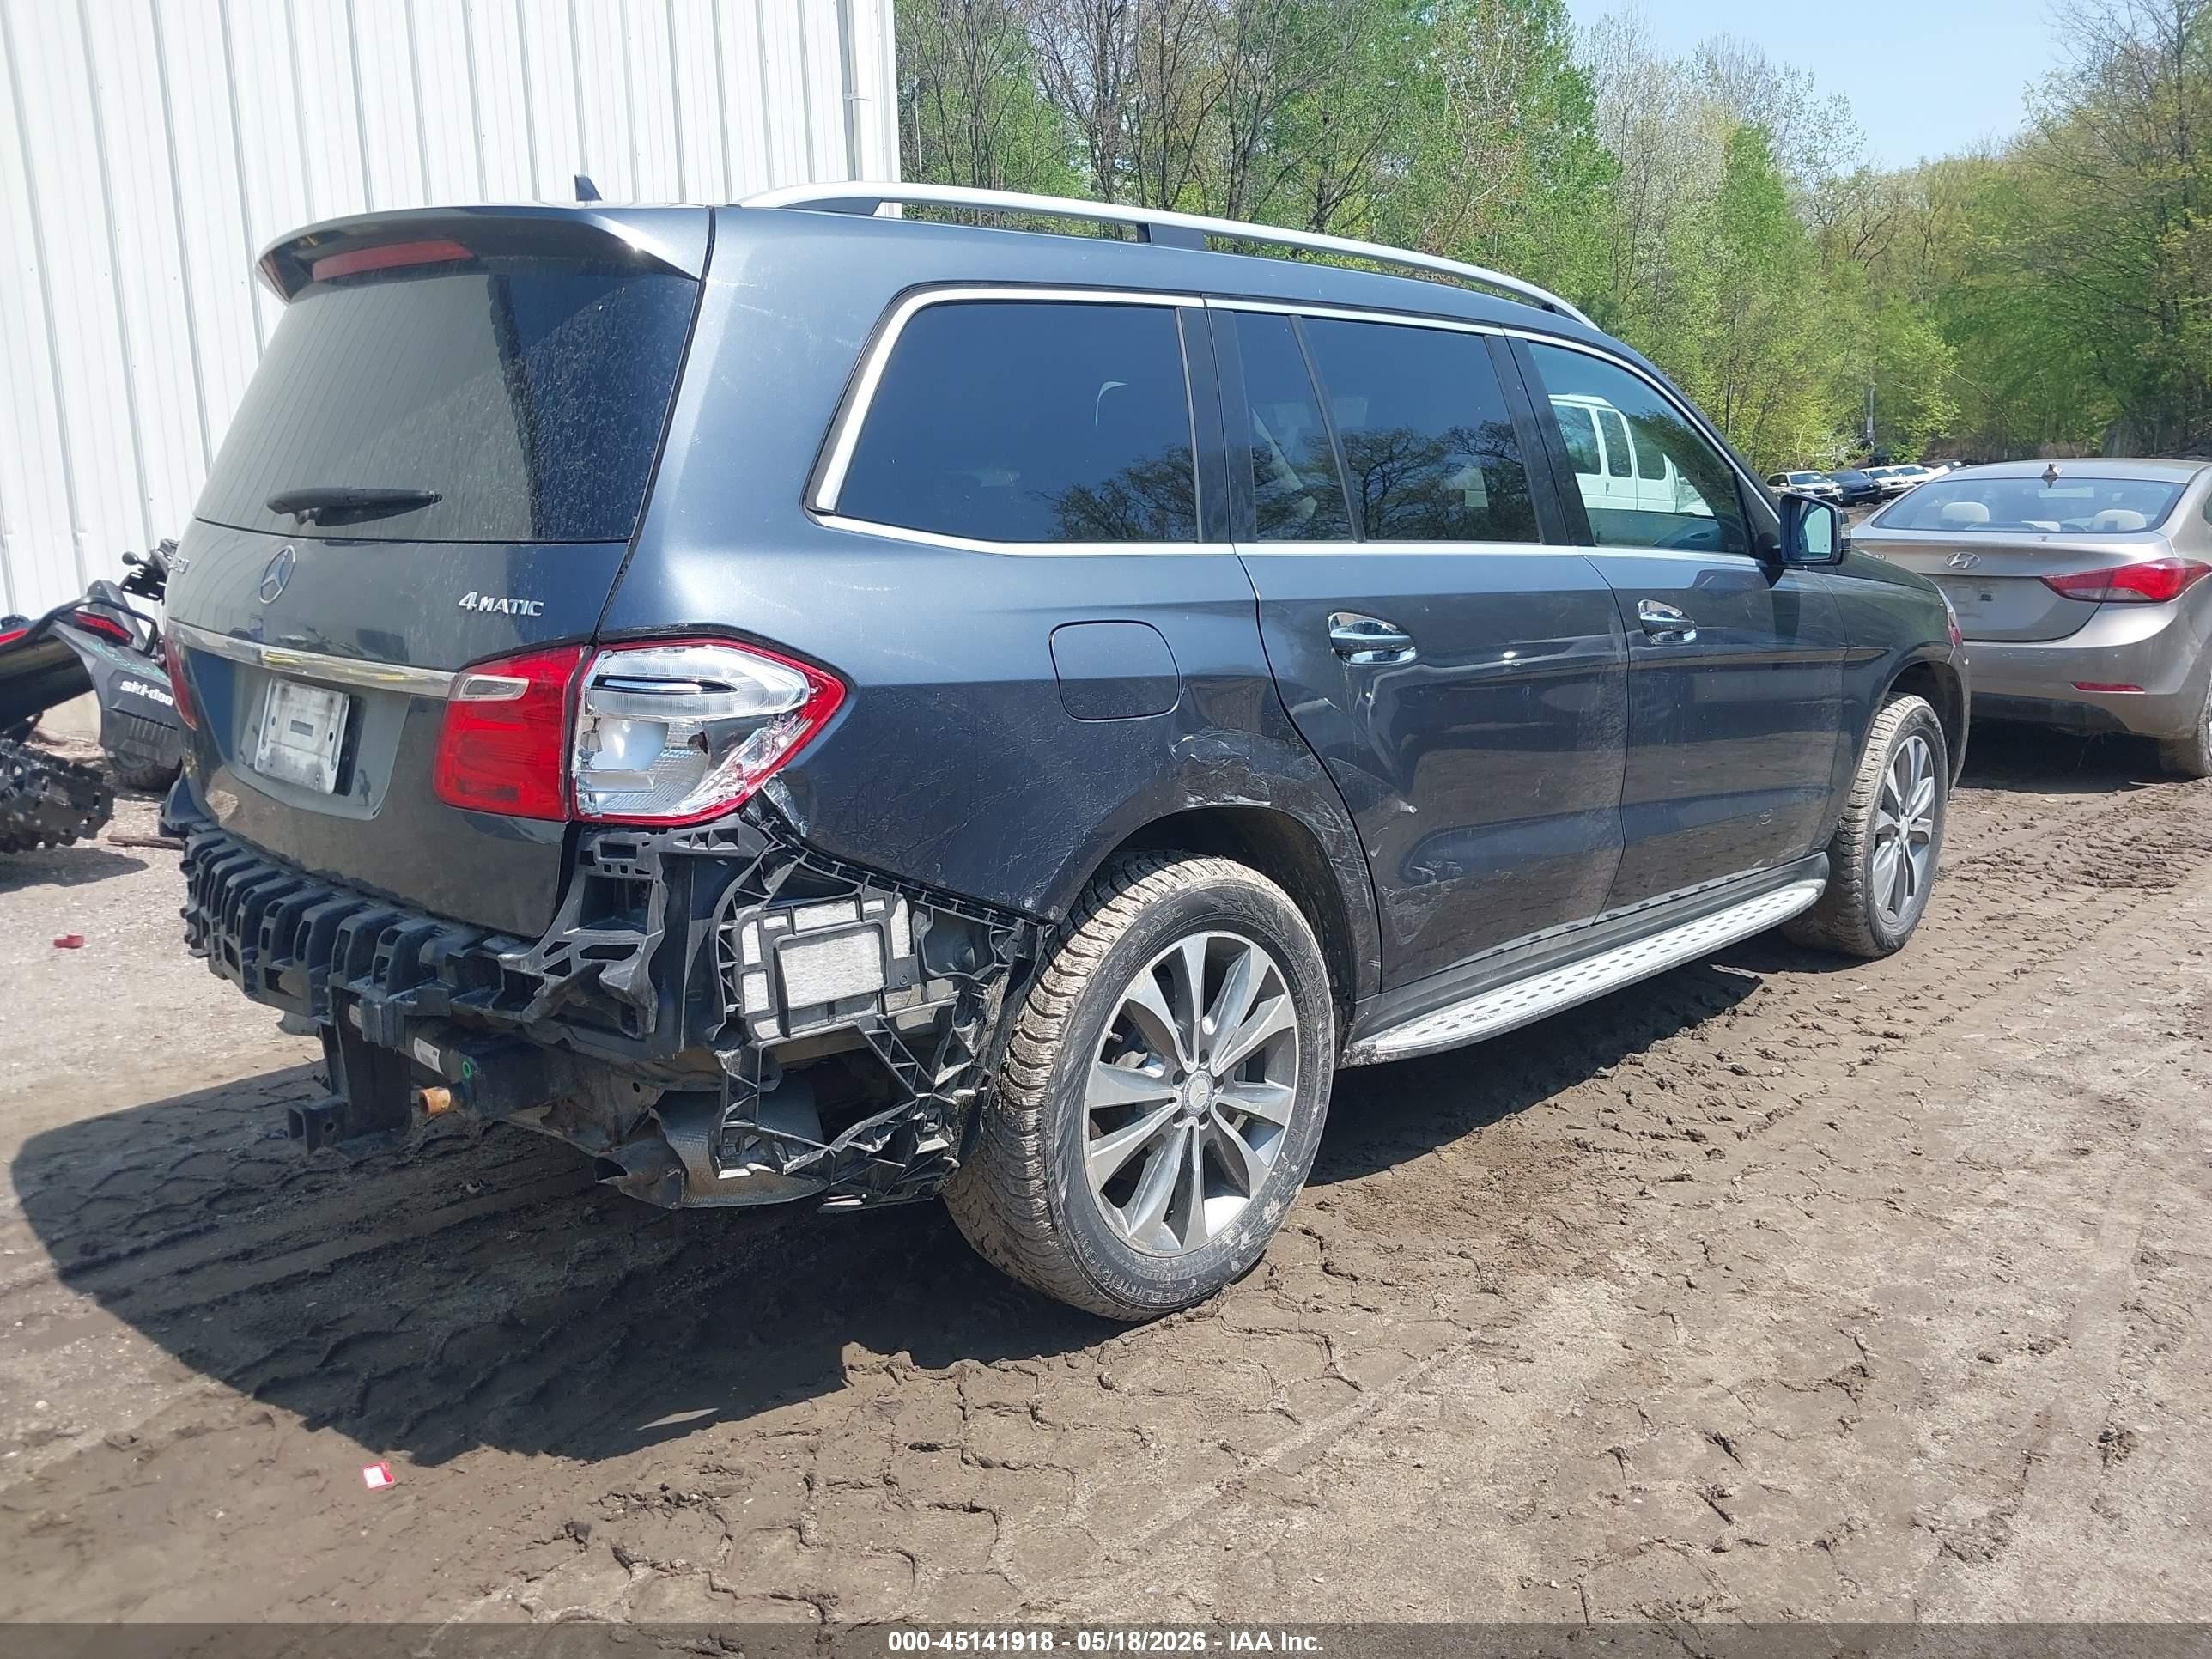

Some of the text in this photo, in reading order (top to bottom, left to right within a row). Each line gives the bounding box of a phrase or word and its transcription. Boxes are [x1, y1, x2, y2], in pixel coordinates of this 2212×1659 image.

[458, 591, 544, 617] 4MATIC
[120, 680, 173, 706] ski-doo
[1074, 1230, 1099, 1265] SUV
